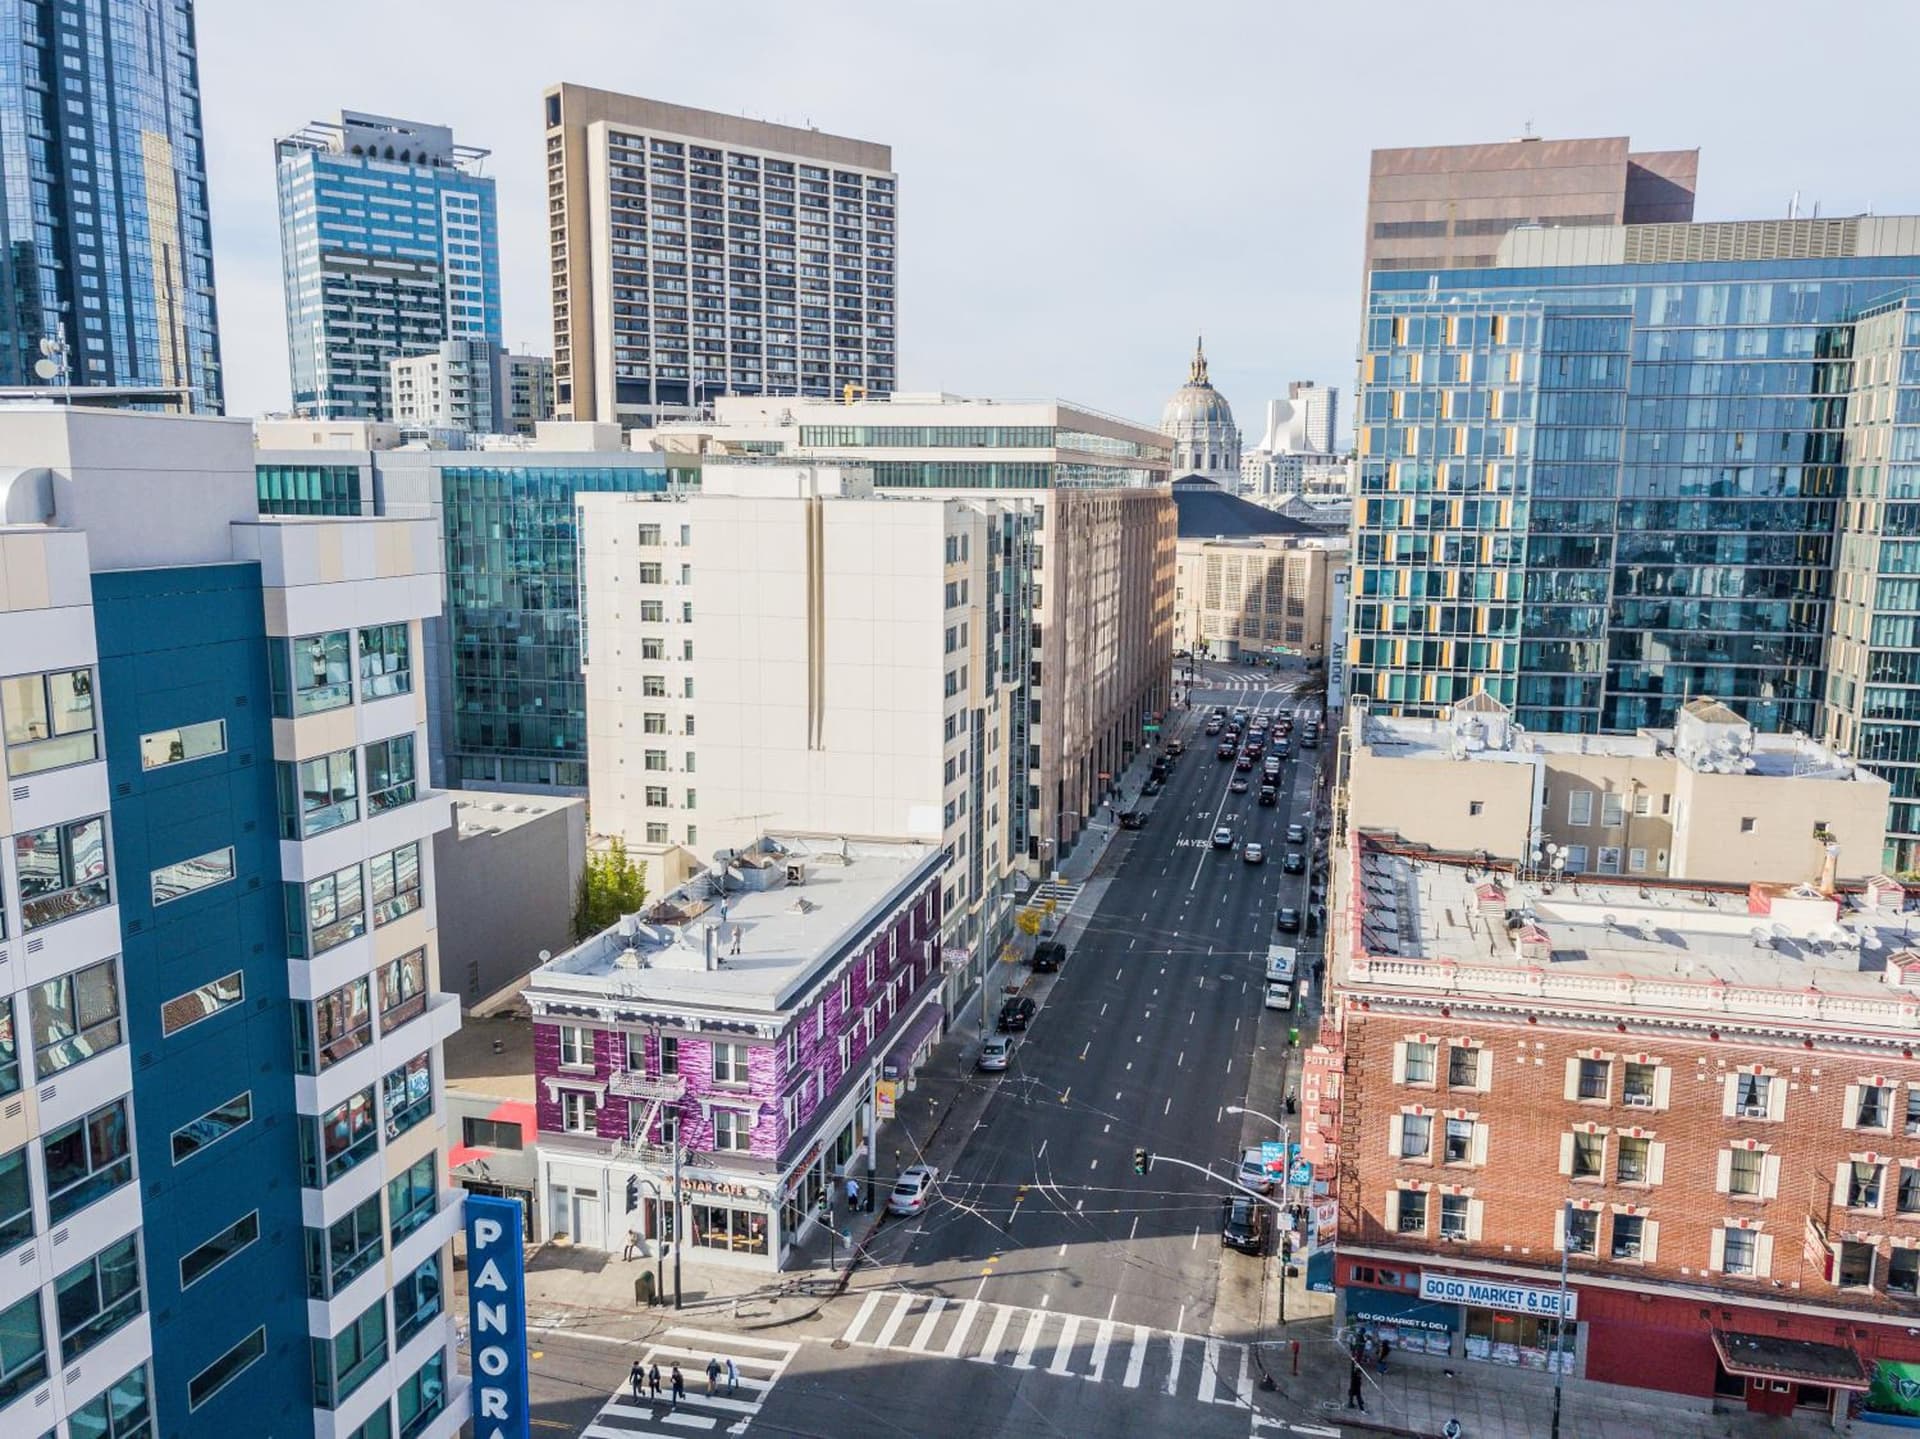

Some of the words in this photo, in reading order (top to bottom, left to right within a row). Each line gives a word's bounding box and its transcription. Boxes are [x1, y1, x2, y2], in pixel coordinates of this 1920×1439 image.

[1176, 839, 1208, 848] HAYES
[1304, 1055, 1341, 1067] POTTER
[1304, 1073, 1321, 1149] HOTEL
[1468, 1286, 1524, 1304] MARKET
[1527, 1292, 1538, 1307] &
[1541, 1295, 1570, 1311] DEI
[1357, 1311, 1371, 1320] GO
[1372, 1313, 1385, 1322] GO
[1386, 1316, 1420, 1327] MARKET
[1429, 1322, 1448, 1331] DELI
